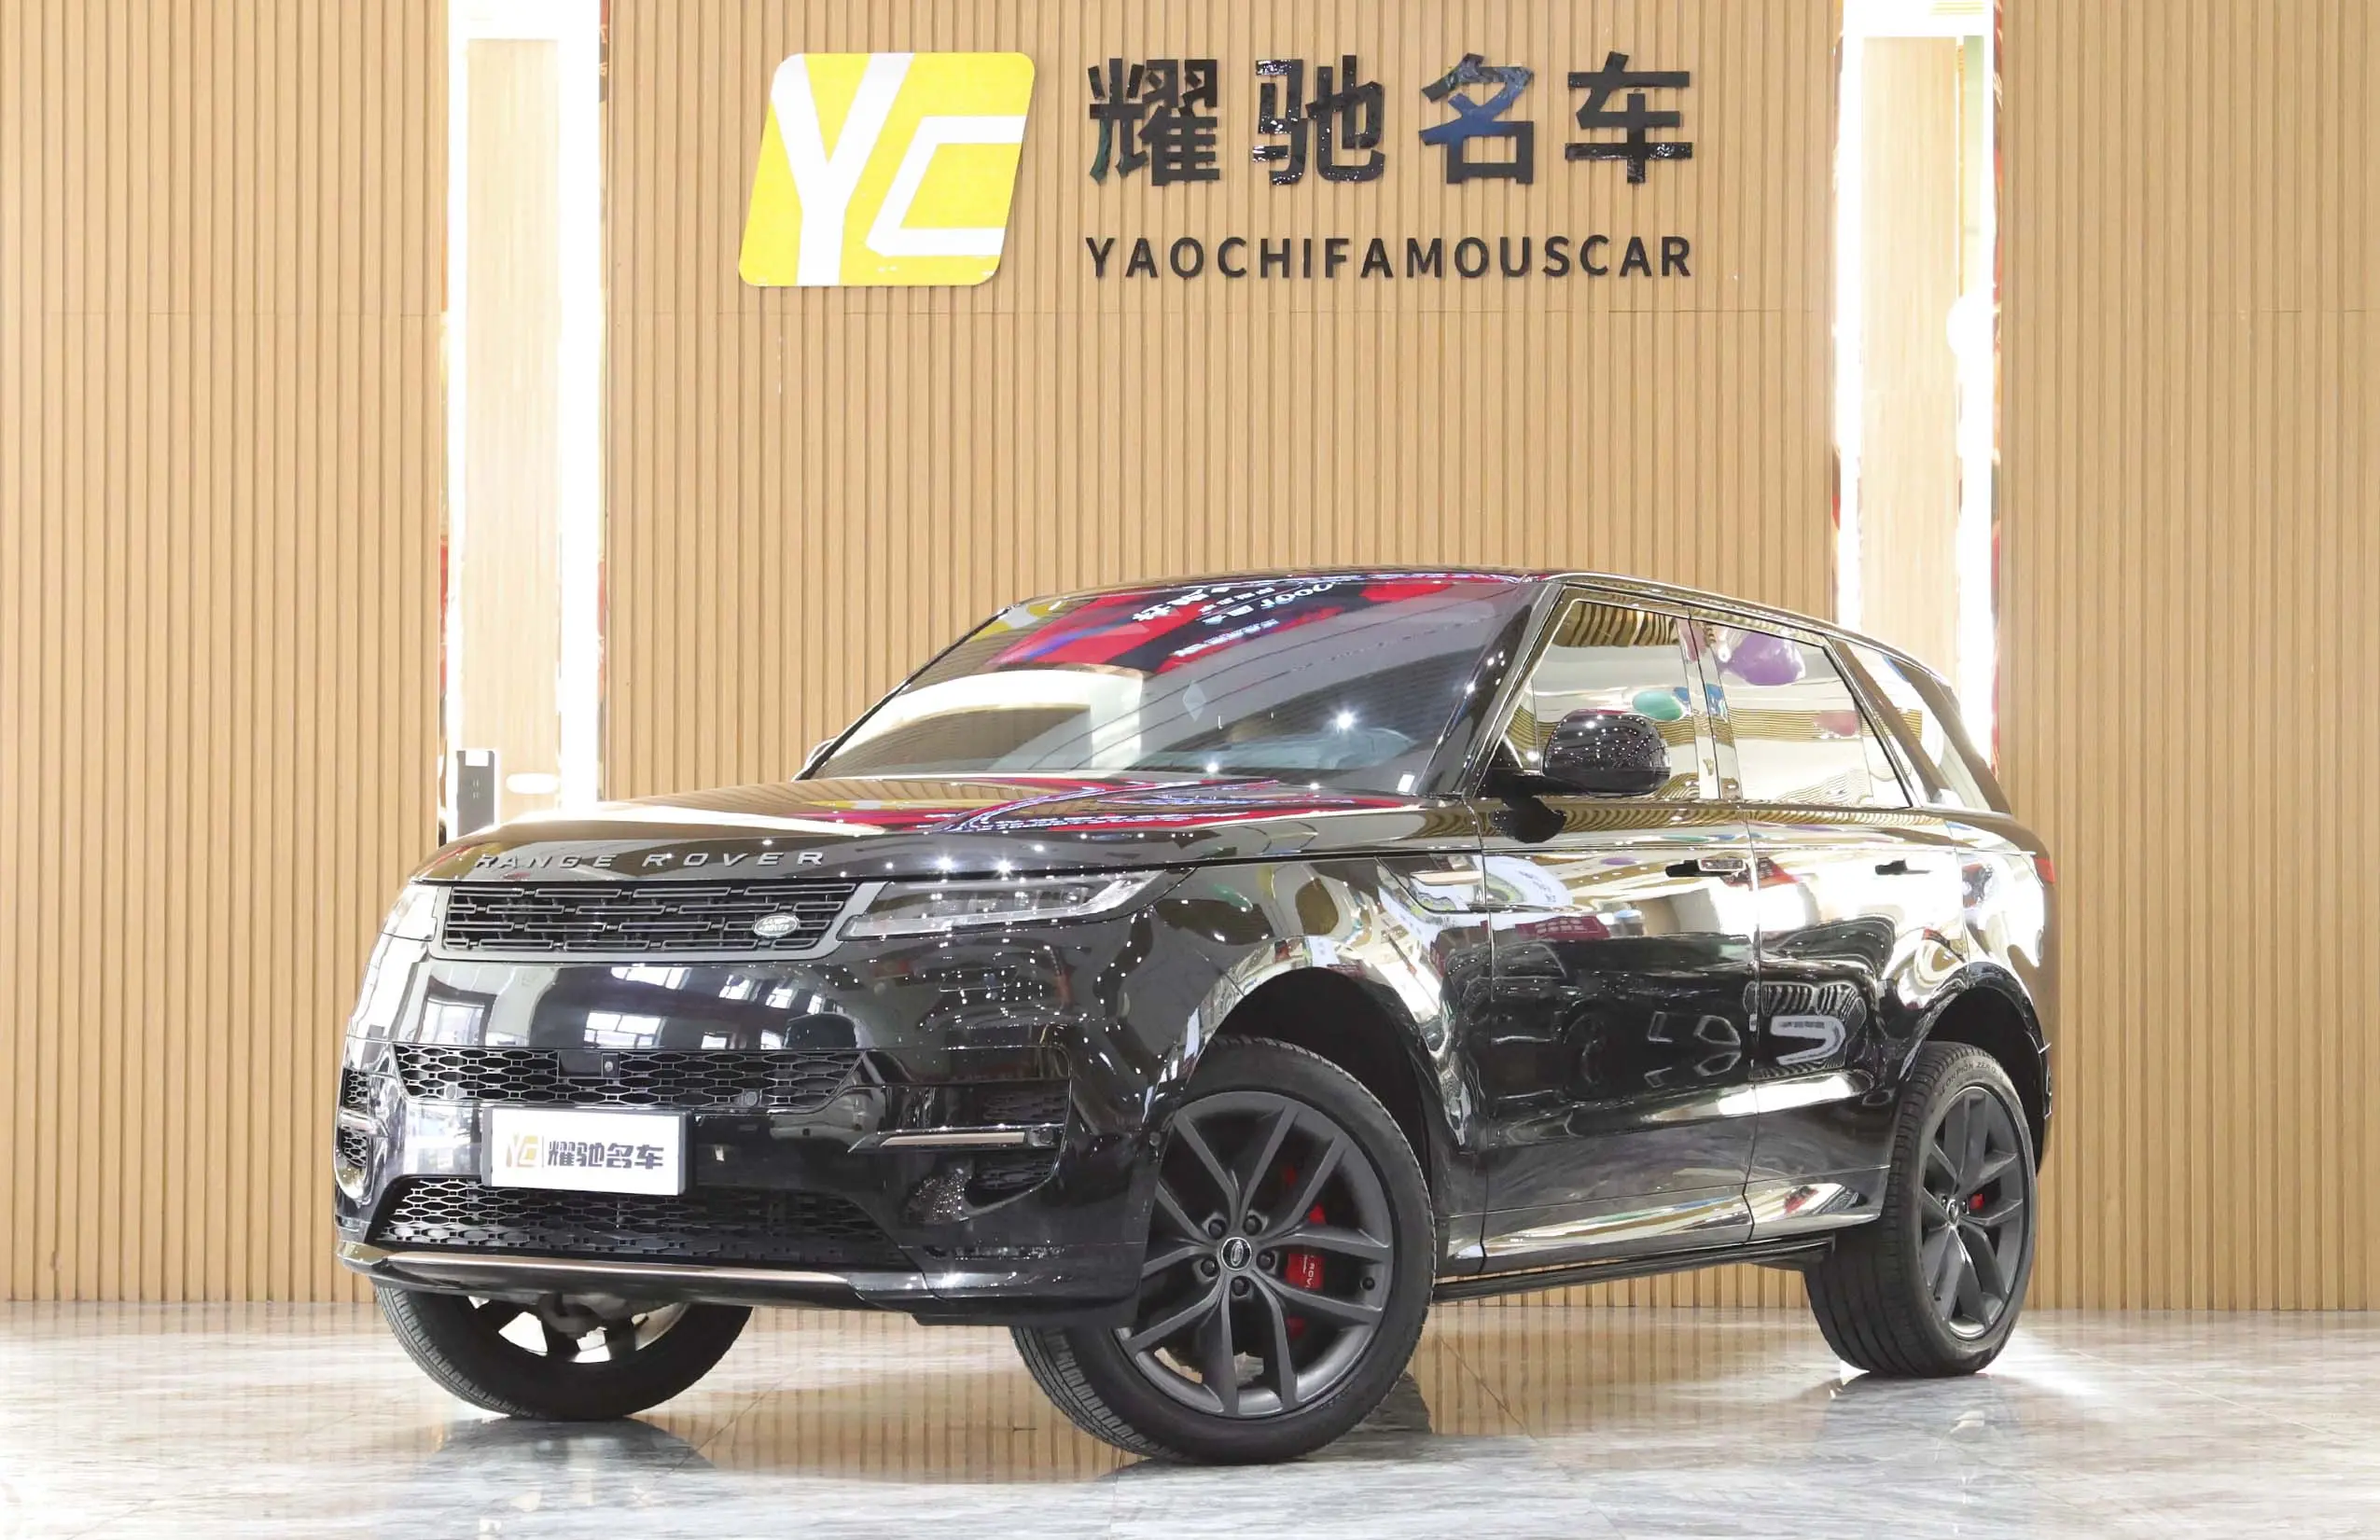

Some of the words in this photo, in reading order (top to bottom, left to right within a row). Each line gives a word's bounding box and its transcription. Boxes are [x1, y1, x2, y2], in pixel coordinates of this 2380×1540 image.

[1087, 51, 1693, 186] 耀驰名车
[1085, 234, 1692, 279] YAOCHIFAMOUSCAR
[473, 853, 618, 868] RANGE
[641, 852, 824, 867] ROVER
[548, 1141, 664, 1170] 耀驰名车
